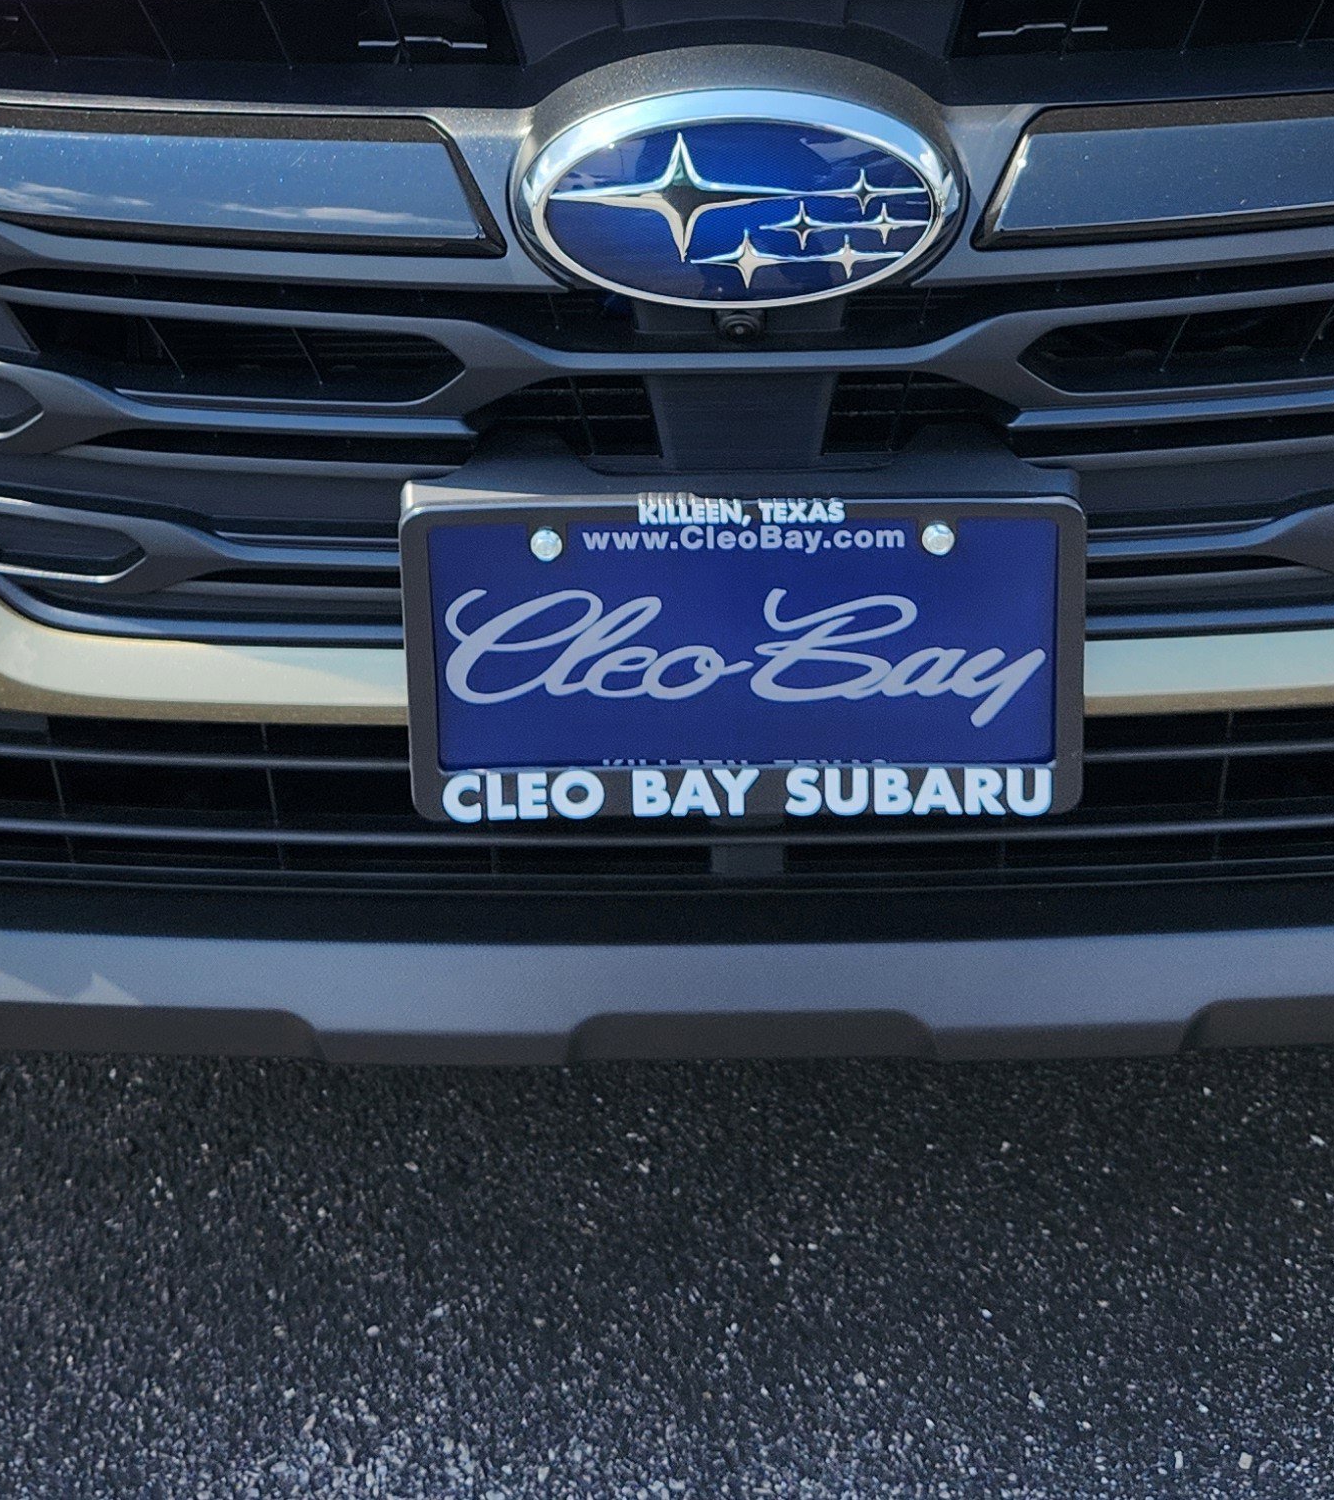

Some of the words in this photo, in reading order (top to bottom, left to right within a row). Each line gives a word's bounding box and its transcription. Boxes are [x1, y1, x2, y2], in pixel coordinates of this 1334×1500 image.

[637, 498, 751, 526] KILLEEN,
[758, 498, 845, 523] TEXAS
[582, 525, 905, 553] www.CleoBay.com
[445, 589, 753, 703] Cleo
[750, 589, 1046, 727] Bay
[442, 769, 605, 821] CLEO
[632, 769, 759, 816] BAY
[785, 767, 1052, 816] SUBARU
